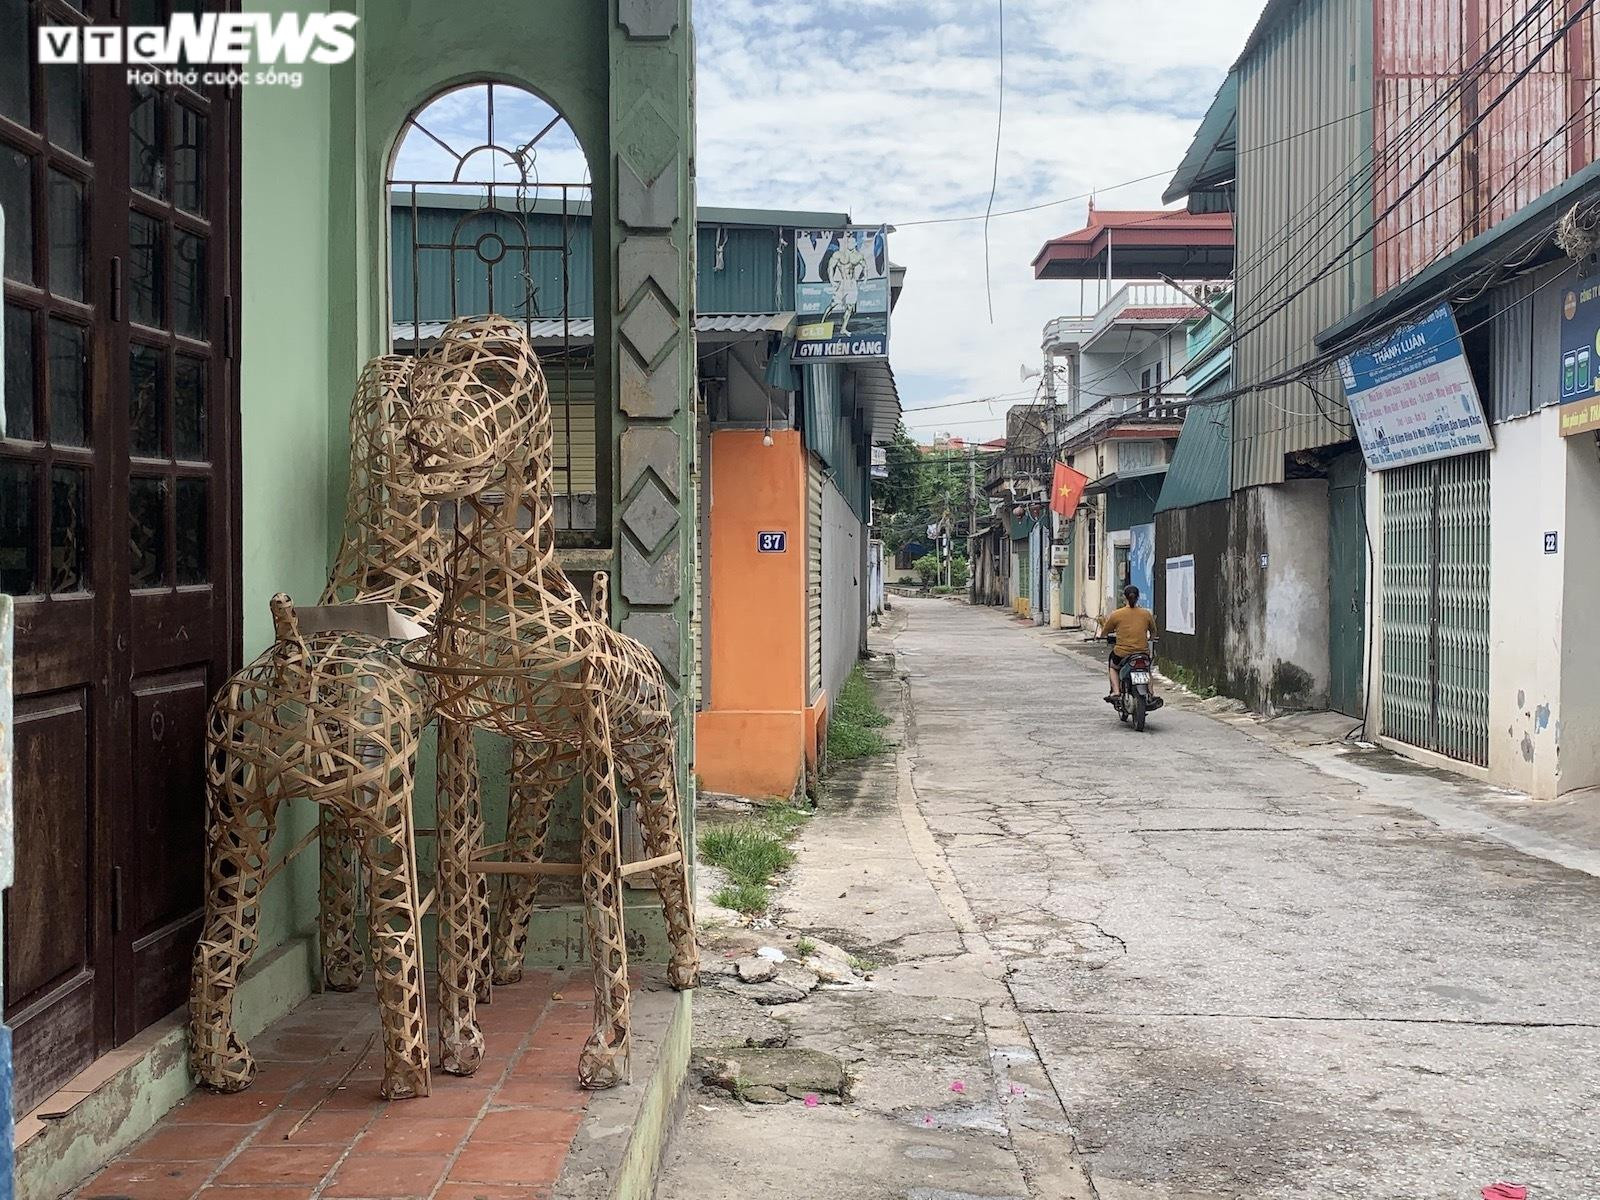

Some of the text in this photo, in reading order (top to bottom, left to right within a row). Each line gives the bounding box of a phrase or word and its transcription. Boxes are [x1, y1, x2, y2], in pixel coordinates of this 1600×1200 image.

[1400, 333, 1426, 352] LUÂN
[763, 534, 781, 550] 37
[1546, 534, 1555, 551] 22
